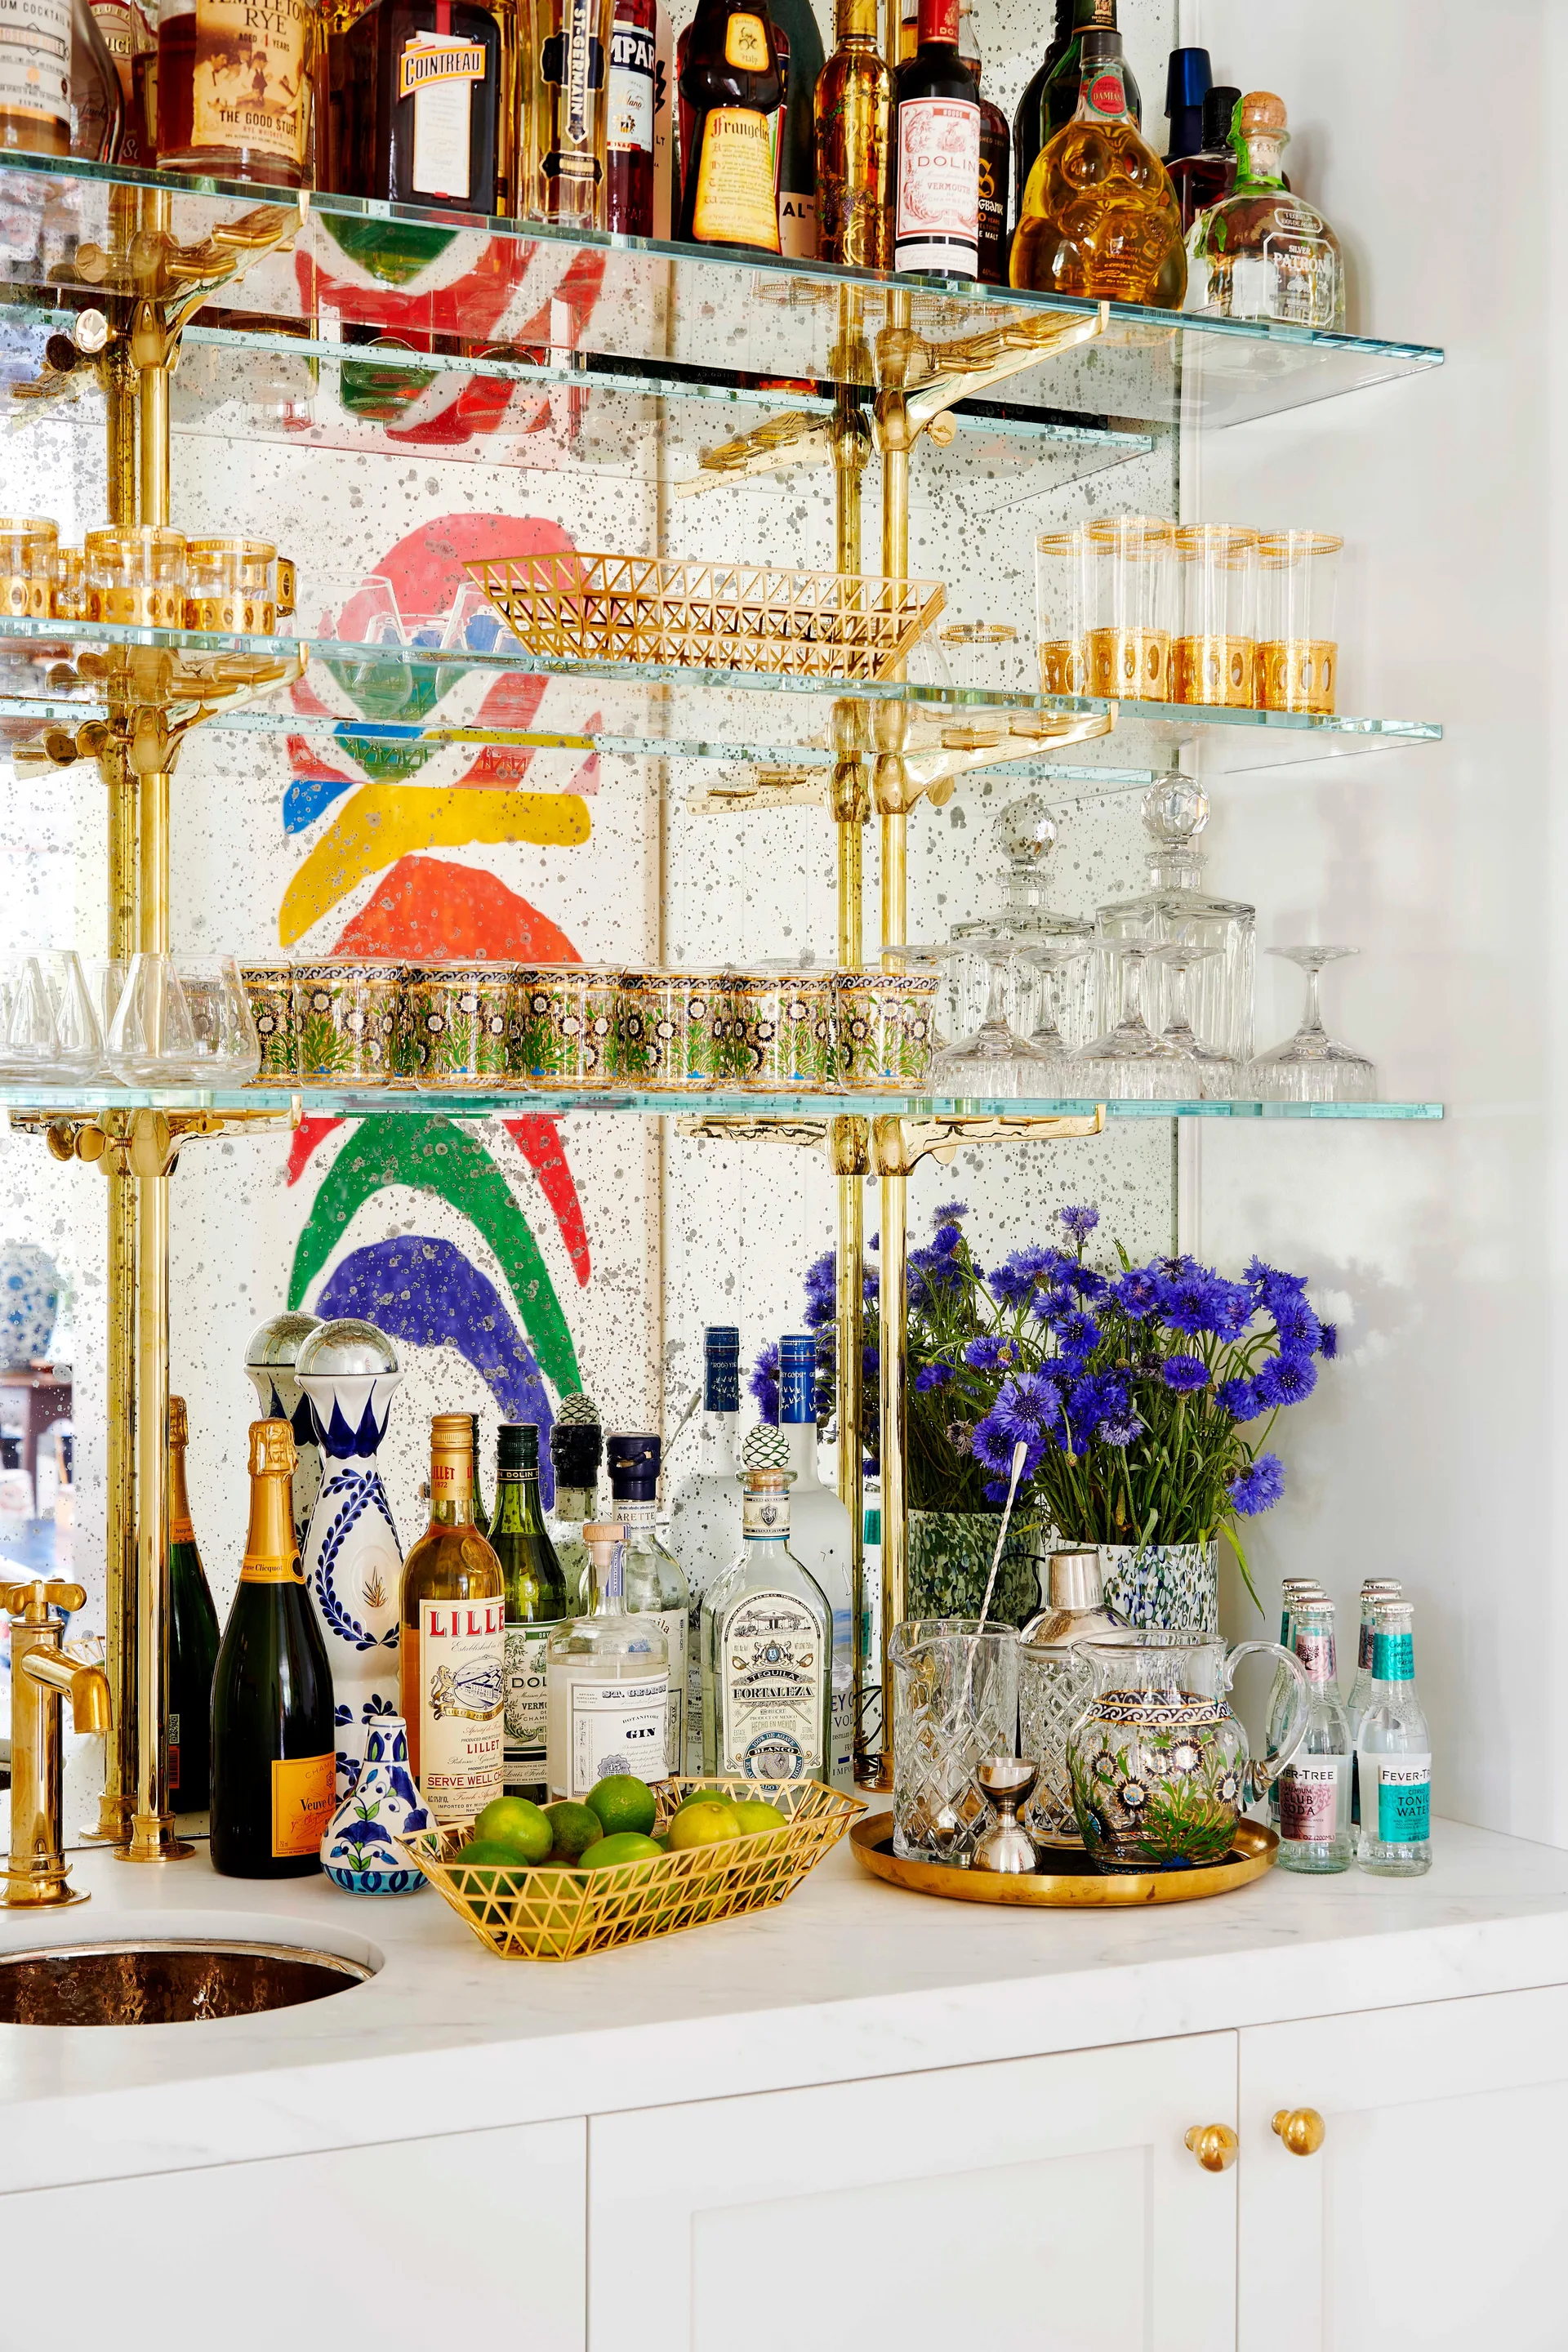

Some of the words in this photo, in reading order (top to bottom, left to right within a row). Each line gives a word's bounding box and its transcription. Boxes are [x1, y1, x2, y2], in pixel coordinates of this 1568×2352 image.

[23, 2, 65, 27] COCKTAIL
[244, 7, 287, 35] RYE
[238, 33, 257, 43] AGED
[272, 38, 290, 52] YEARS
[568, 7, 588, 116] ST-GERMAIN
[405, 53, 480, 86] COINTREAU
[220, 110, 240, 123] THE
[245, 112, 273, 128] GOOD
[276, 118, 297, 137] STUFF
[918, 155, 976, 173] DOLIN
[927, 181, 970, 194] VERMOUTH
[987, 217, 1000, 226] YEARS
[985, 230, 999, 241] MALT
[1289, 244, 1311, 255] SILVER
[1273, 252, 1328, 274] PATRÓN
[506, 1470, 533, 1478] DOLIN
[617, 1512, 655, 1521] ARETTE
[255, 1563, 283, 1573] Clicquot
[451, 1640, 491, 1653] Established
[749, 1669, 795, 1681] TEQUILA
[601, 1690, 625, 1699] ST.
[733, 1686, 813, 1699] FORTALEZA
[622, 1714, 660, 1724] BOTANIVORE
[751, 1720, 768, 1733] HECHO
[769, 1720, 777, 1728] EN
[777, 1720, 796, 1732] MEXICO
[626, 1727, 657, 1740] GIN
[752, 1735, 765, 1748] 100%
[776, 1732, 795, 1746] AGAVE
[800, 1733, 815, 1741] GROUND
[832, 1731, 850, 1740] DISTILLED
[466, 1740, 500, 1754] LILLET
[754, 1746, 795, 1755] BLANCO
[427, 1776, 464, 1787] SERVE
[467, 1775, 492, 1786] WELL
[300, 1797, 327, 1812] Veuve
[1284, 1793, 1313, 1805] CLUB
[1283, 1802, 1316, 1815] SODA
